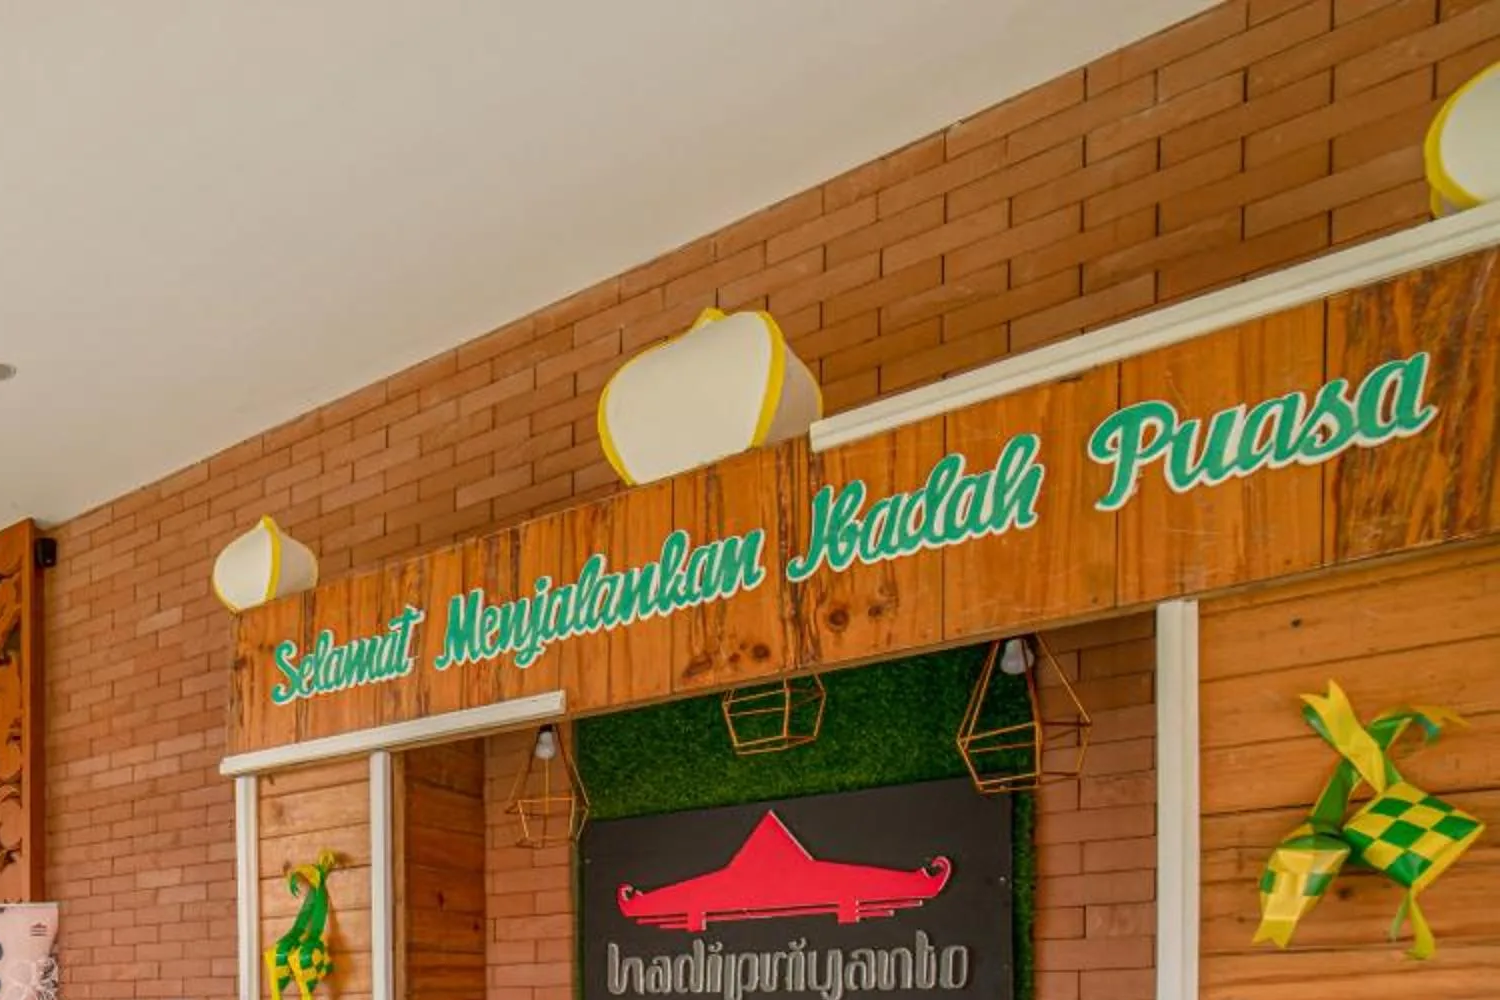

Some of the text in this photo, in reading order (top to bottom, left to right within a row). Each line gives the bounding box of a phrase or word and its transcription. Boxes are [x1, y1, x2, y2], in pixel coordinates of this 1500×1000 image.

[271, 351, 1437, 706] Selamat Menjalankan Ibadah Puasa
